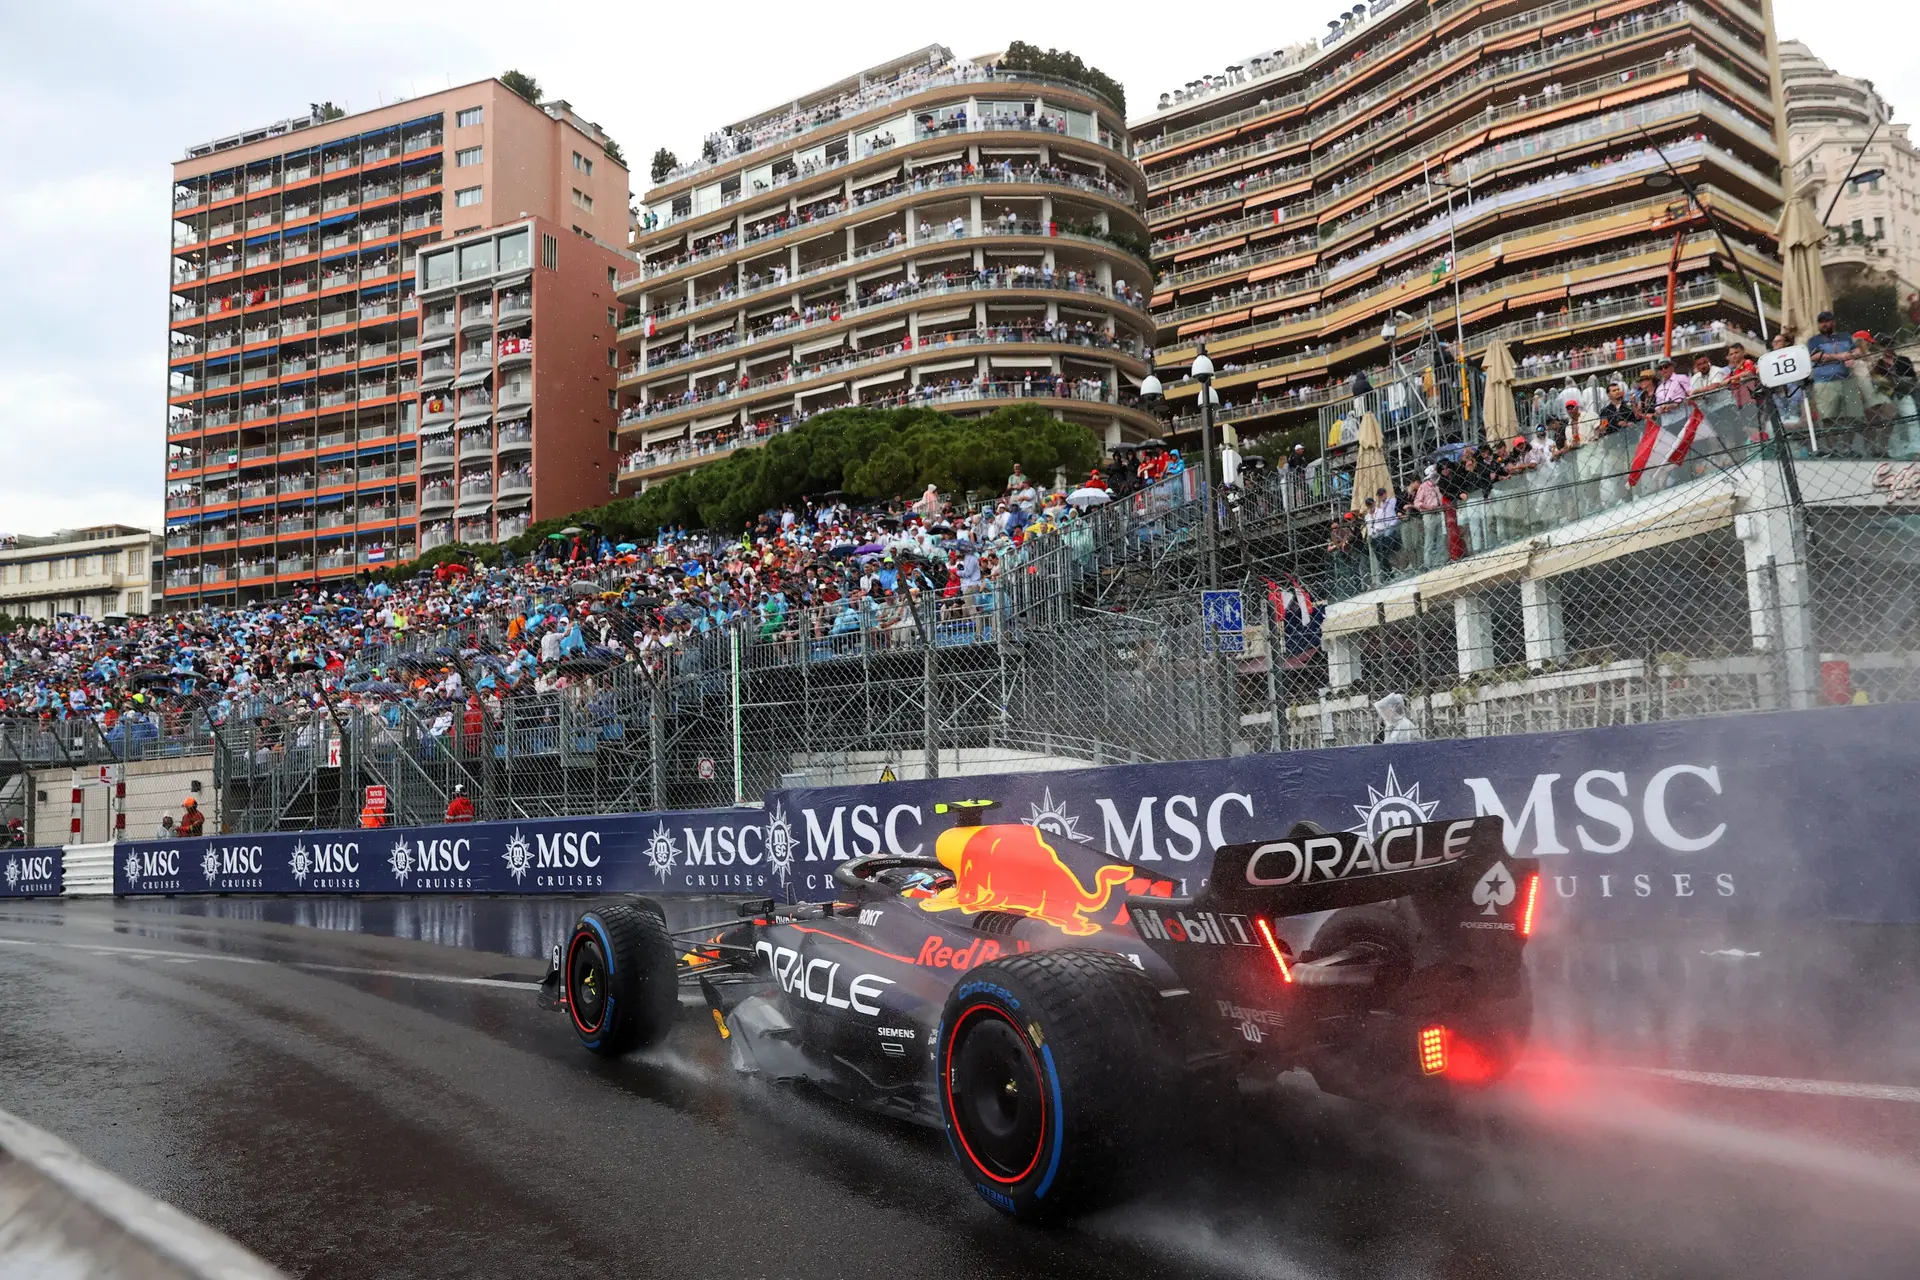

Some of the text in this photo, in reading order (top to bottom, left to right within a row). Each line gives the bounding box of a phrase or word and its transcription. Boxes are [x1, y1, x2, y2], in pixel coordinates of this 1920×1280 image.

[1772, 358, 1797, 377] 18
[330, 749, 338, 766] K
[1463, 764, 1726, 856] MSC
[801, 804, 924, 861] MSC
[1095, 792, 1254, 862] MSC
[313, 842, 360, 873] MSC
[416, 838, 471, 872] MSC
[535, 831, 601, 868] MSC
[683, 825, 763, 866] MSC
[1246, 819, 1476, 886] ORACLE
[21, 856, 53, 881] MSC
[143, 850, 180, 877] MSC
[222, 846, 263, 874] MSC
[21, 883, 53, 893] CRUISES
[143, 880, 180, 889] CRUISES
[221, 879, 263, 888] CRUISES
[313, 878, 360, 888] CRUISES
[417, 878, 472, 888] CRUISES
[537, 875, 602, 886] CRUISES
[685, 874, 764, 886] CRUISES
[1554, 873, 1736, 898] UISES
[858, 909, 884, 926] ROKT
[1133, 908, 1251, 945] Mobil 1
[1460, 921, 1516, 931] POKERSTARS
[916, 935, 981, 970] Red
[877, 1027, 915, 1038] SIEMENS
